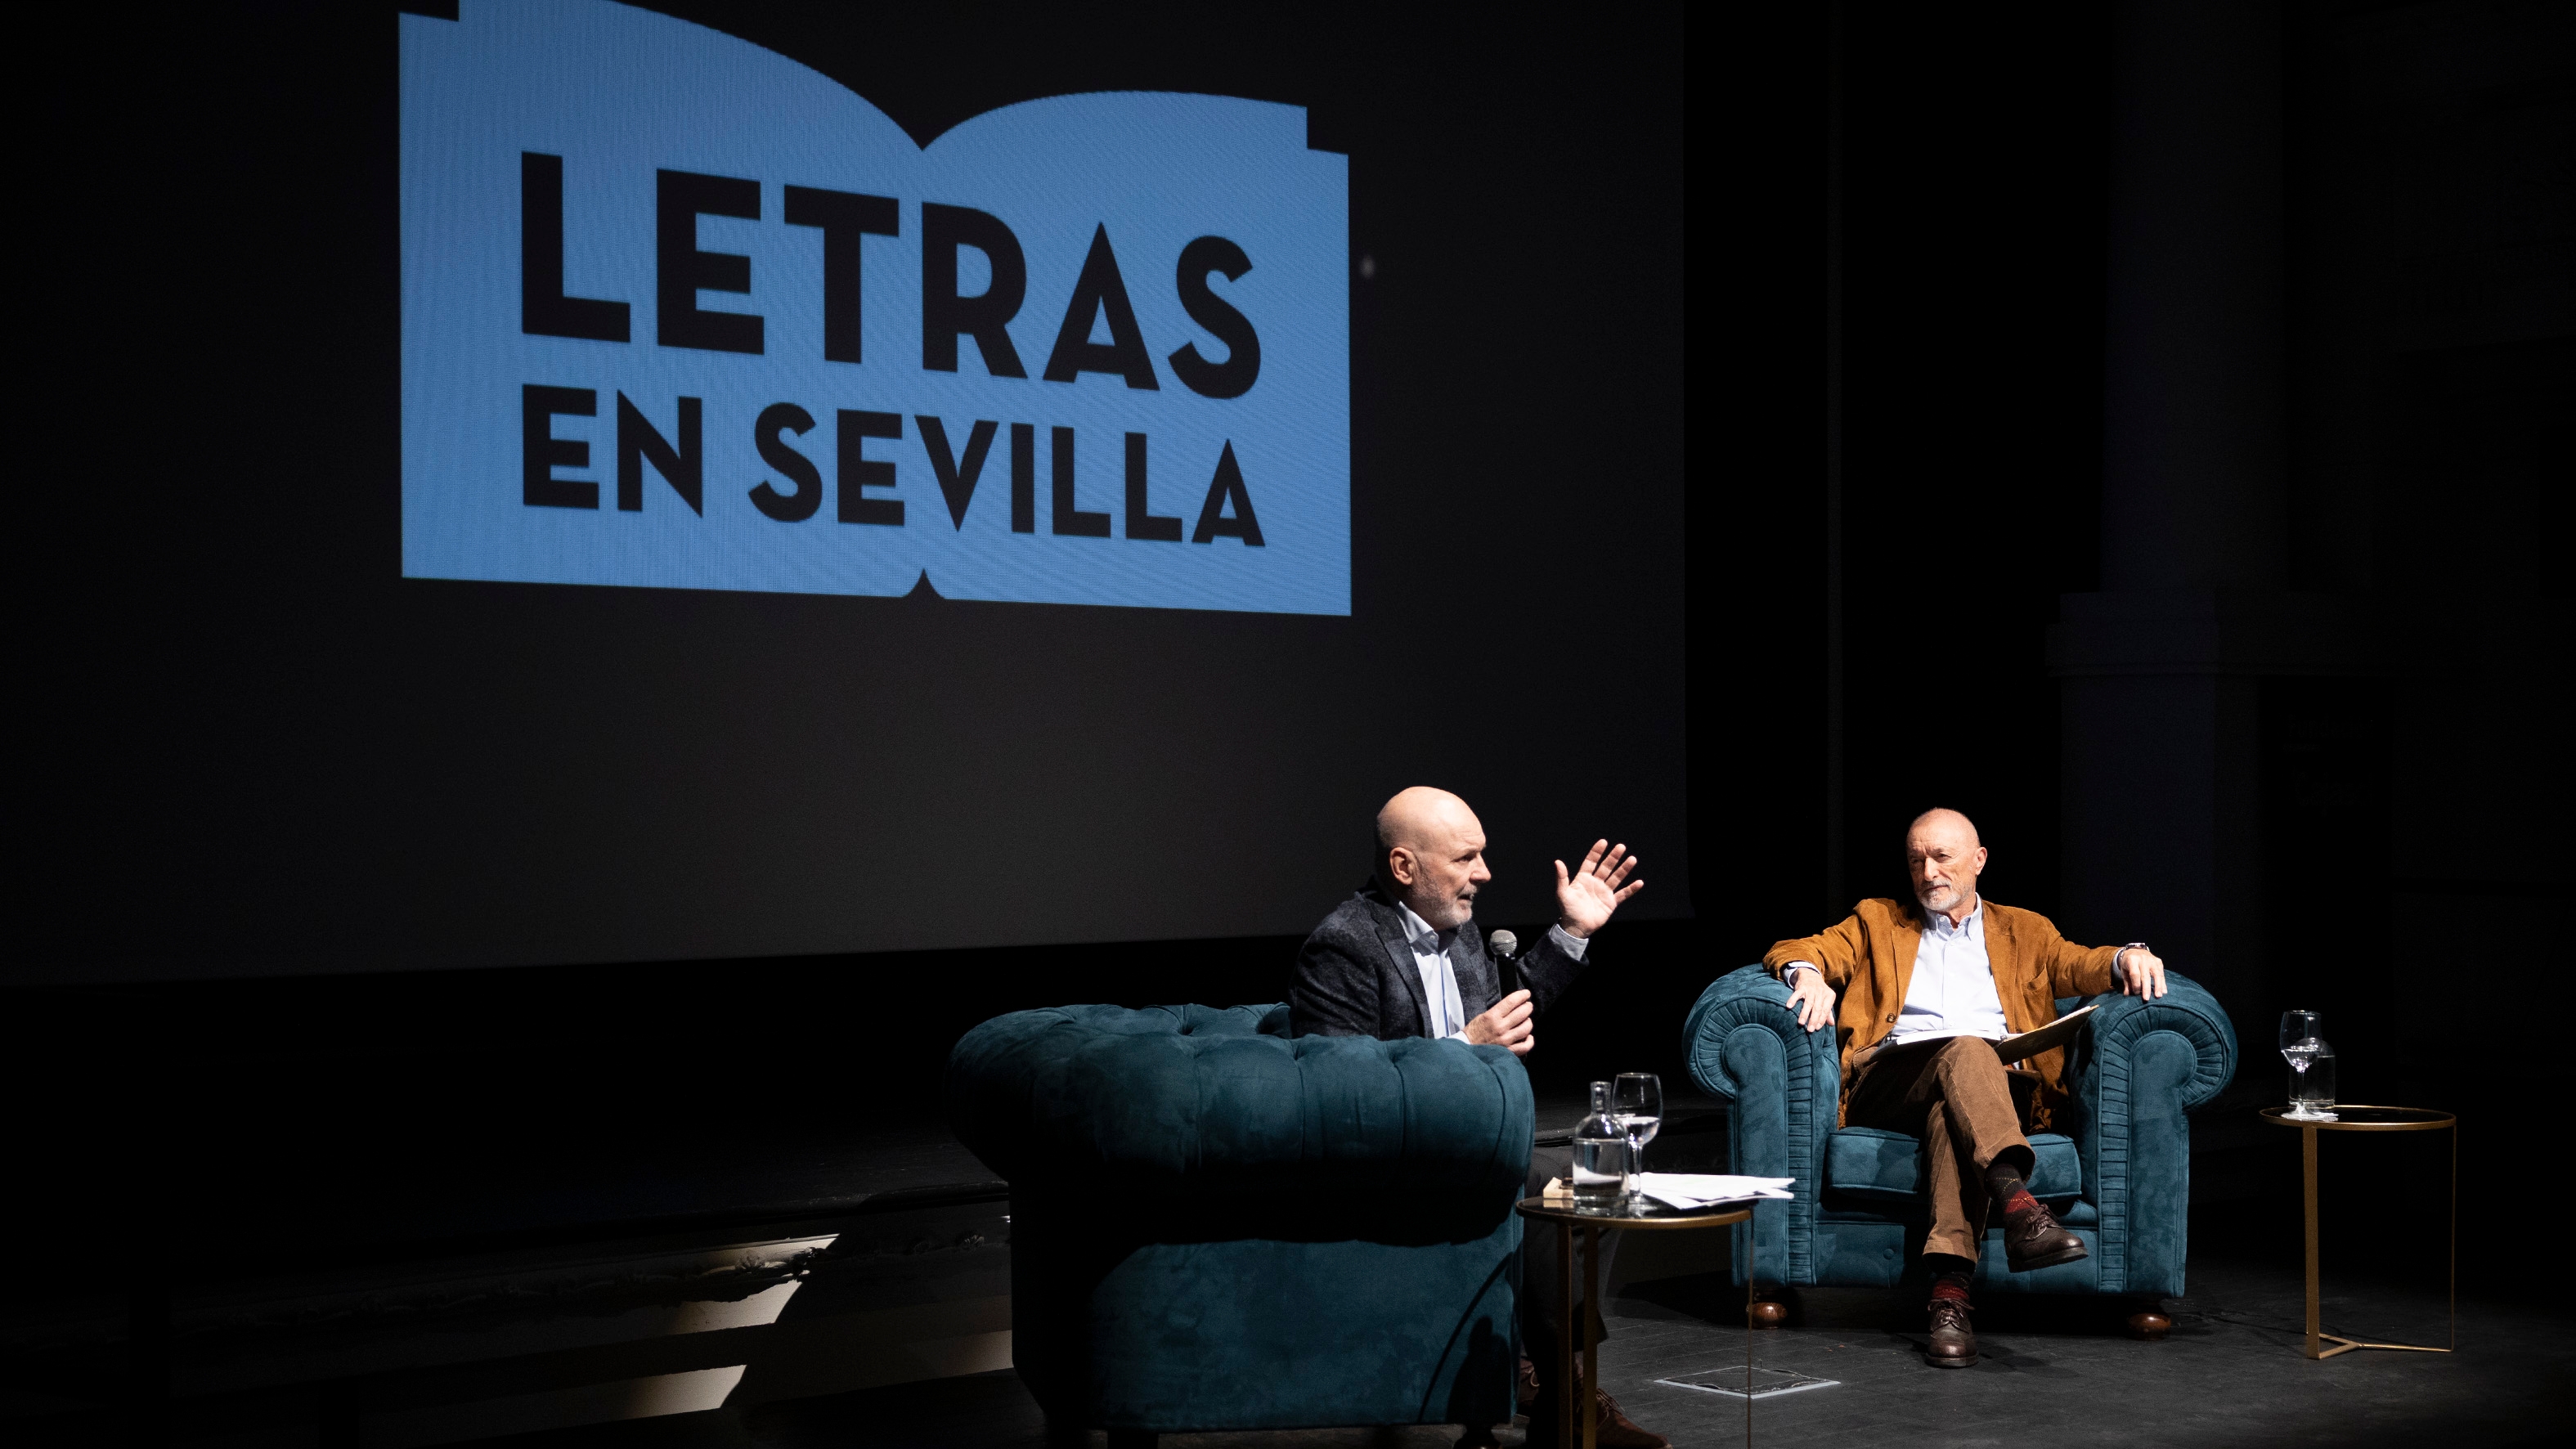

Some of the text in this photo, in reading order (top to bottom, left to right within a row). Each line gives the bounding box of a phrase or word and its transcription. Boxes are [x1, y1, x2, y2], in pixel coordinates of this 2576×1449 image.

[521, 150, 1262, 400] LETRAS
[521, 384, 1265, 547] EN SEVILLA
